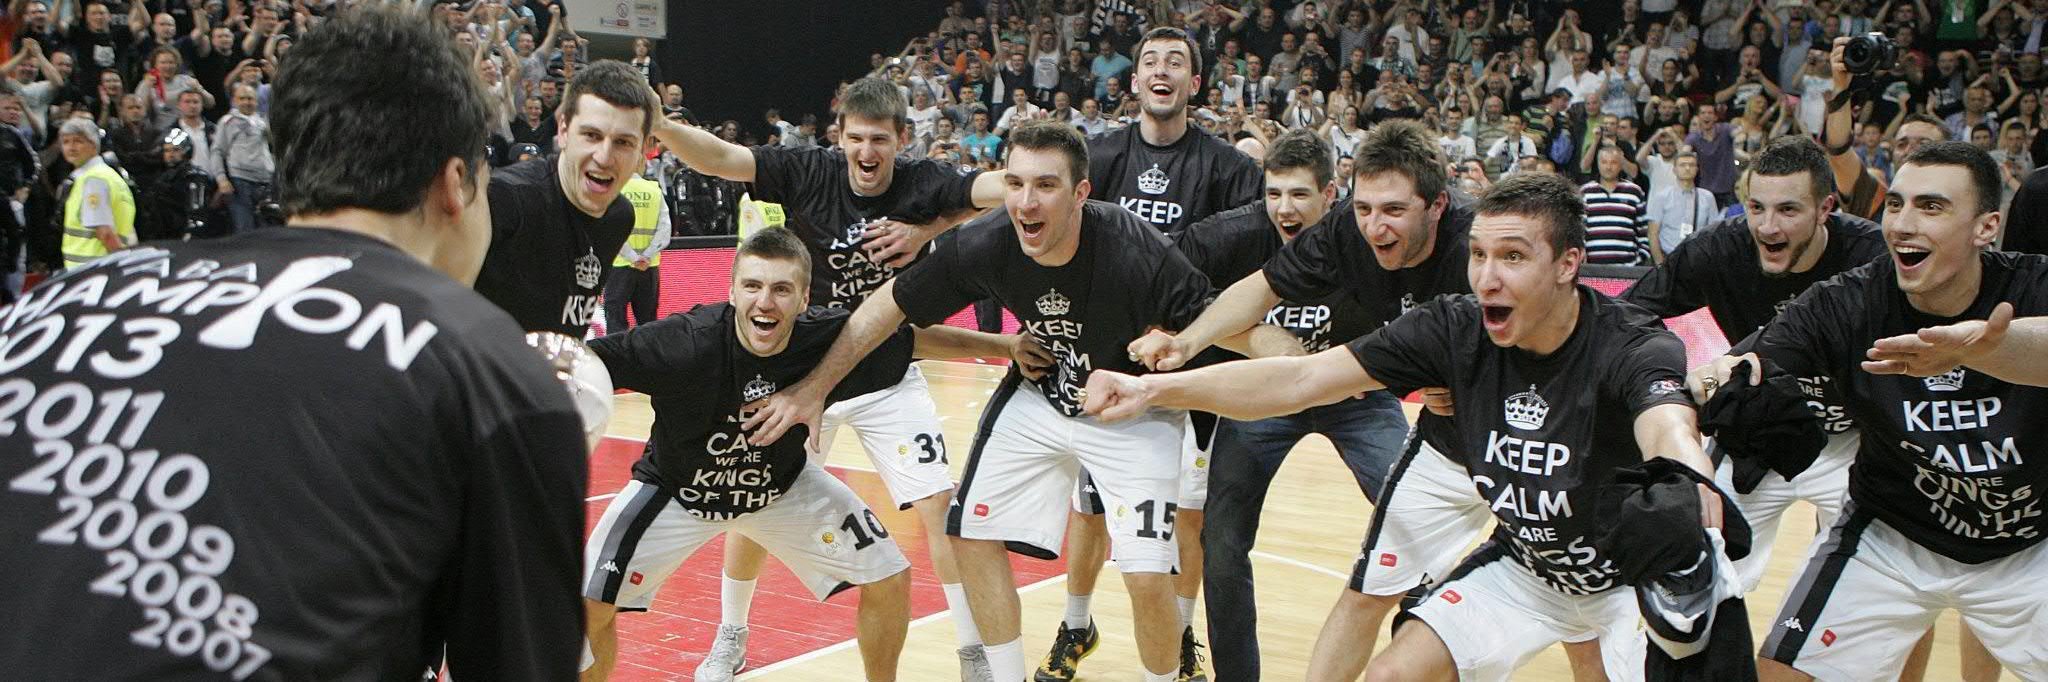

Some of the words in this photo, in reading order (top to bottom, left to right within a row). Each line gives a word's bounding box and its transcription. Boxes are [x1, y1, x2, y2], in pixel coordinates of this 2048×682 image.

[1120, 196, 1183, 224] KEEP
[1025, 319, 1083, 340] KEE
[1265, 304, 1331, 329] KEEP
[0, 313, 182, 380] 013
[0, 378, 166, 450] 2011
[1903, 396, 2002, 432] KEEP
[913, 433, 949, 464] 31
[1484, 430, 1571, 476] KEEP
[8, 438, 210, 513] 2010
[691, 463, 773, 487] KINGS
[679, 486, 721, 504] OF
[729, 487, 782, 508] THE
[37, 498, 235, 577] 2009
[840, 508, 889, 551] 10
[1134, 500, 1178, 542] 15
[1518, 525, 1559, 542] ARE
[89, 549, 259, 641] 2008
[130, 608, 272, 682] 2007
